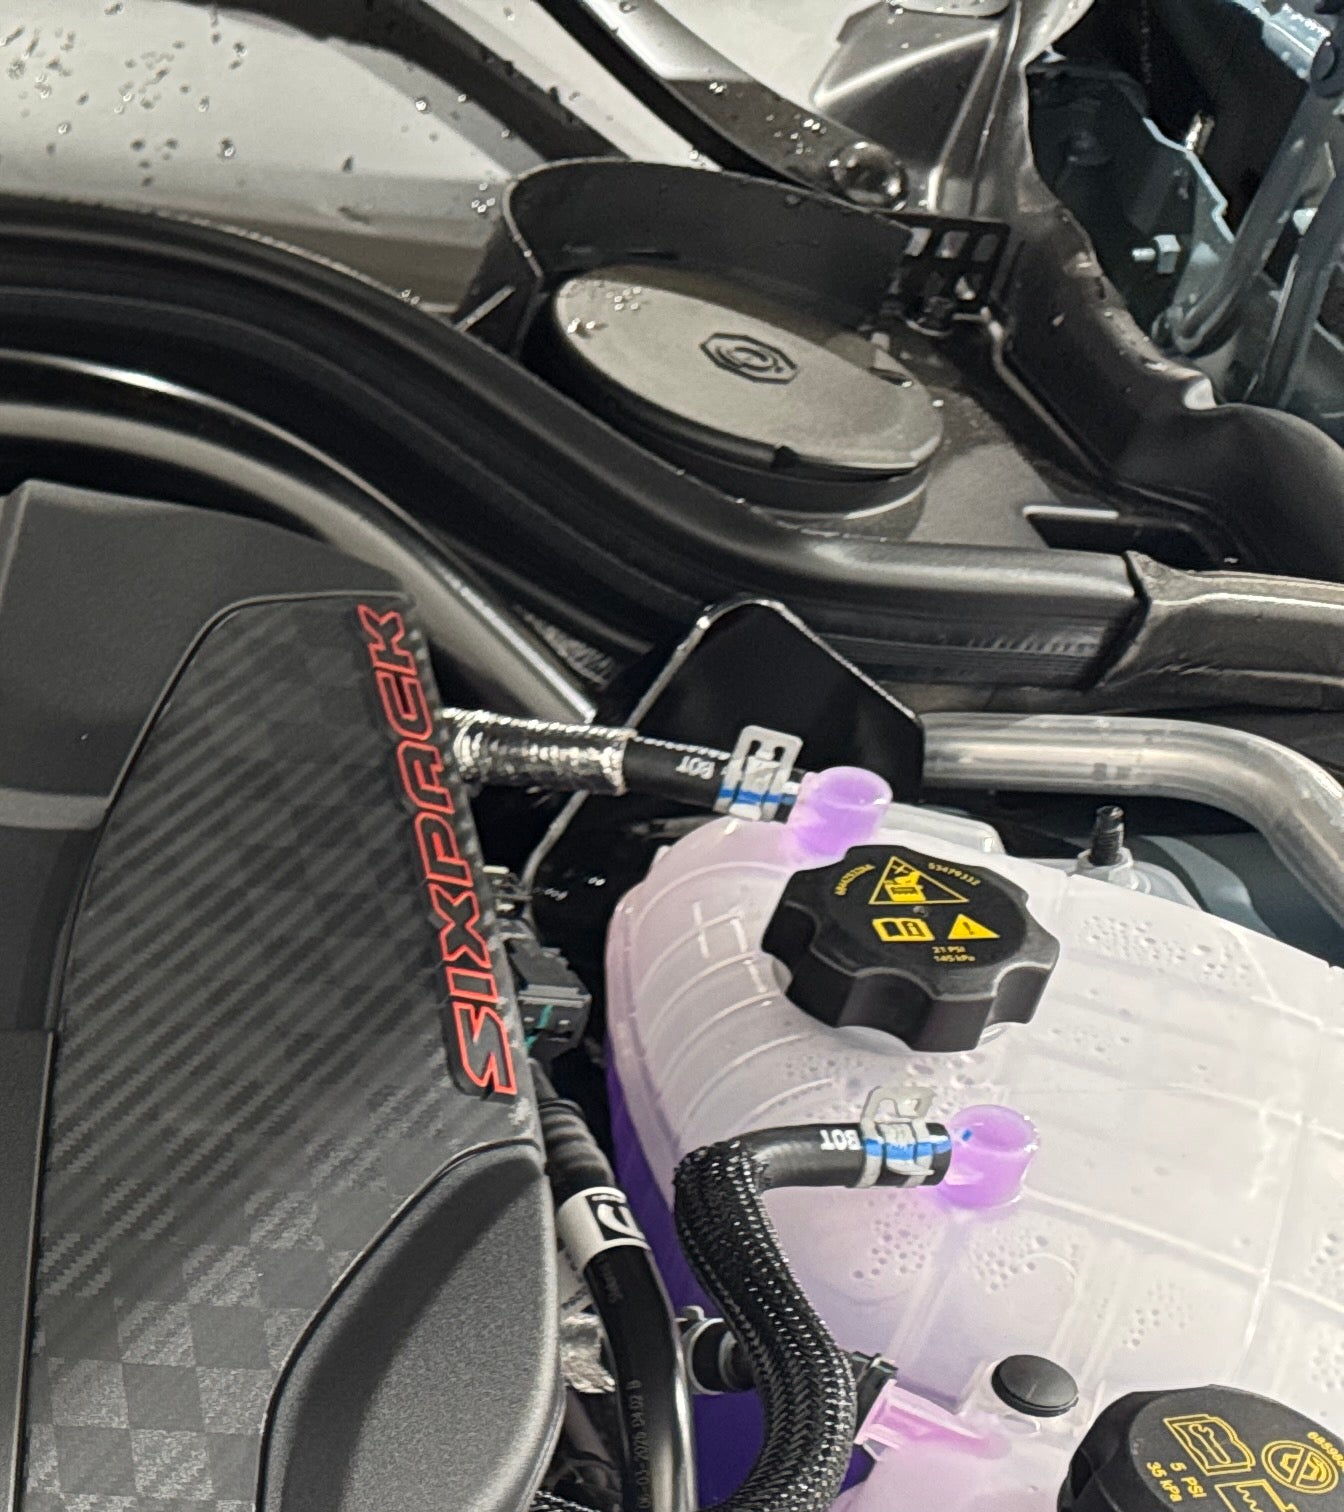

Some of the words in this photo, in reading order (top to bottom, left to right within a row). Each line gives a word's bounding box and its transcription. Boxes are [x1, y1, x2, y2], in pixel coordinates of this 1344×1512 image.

[358, 604, 518, 1095] SIXPACK
[820, 1128, 862, 1151] BOT
[1146, 1461, 1168, 1479] 35
[1169, 1462, 1187, 1472] 5
[1181, 1476, 1208, 1498] PSI
